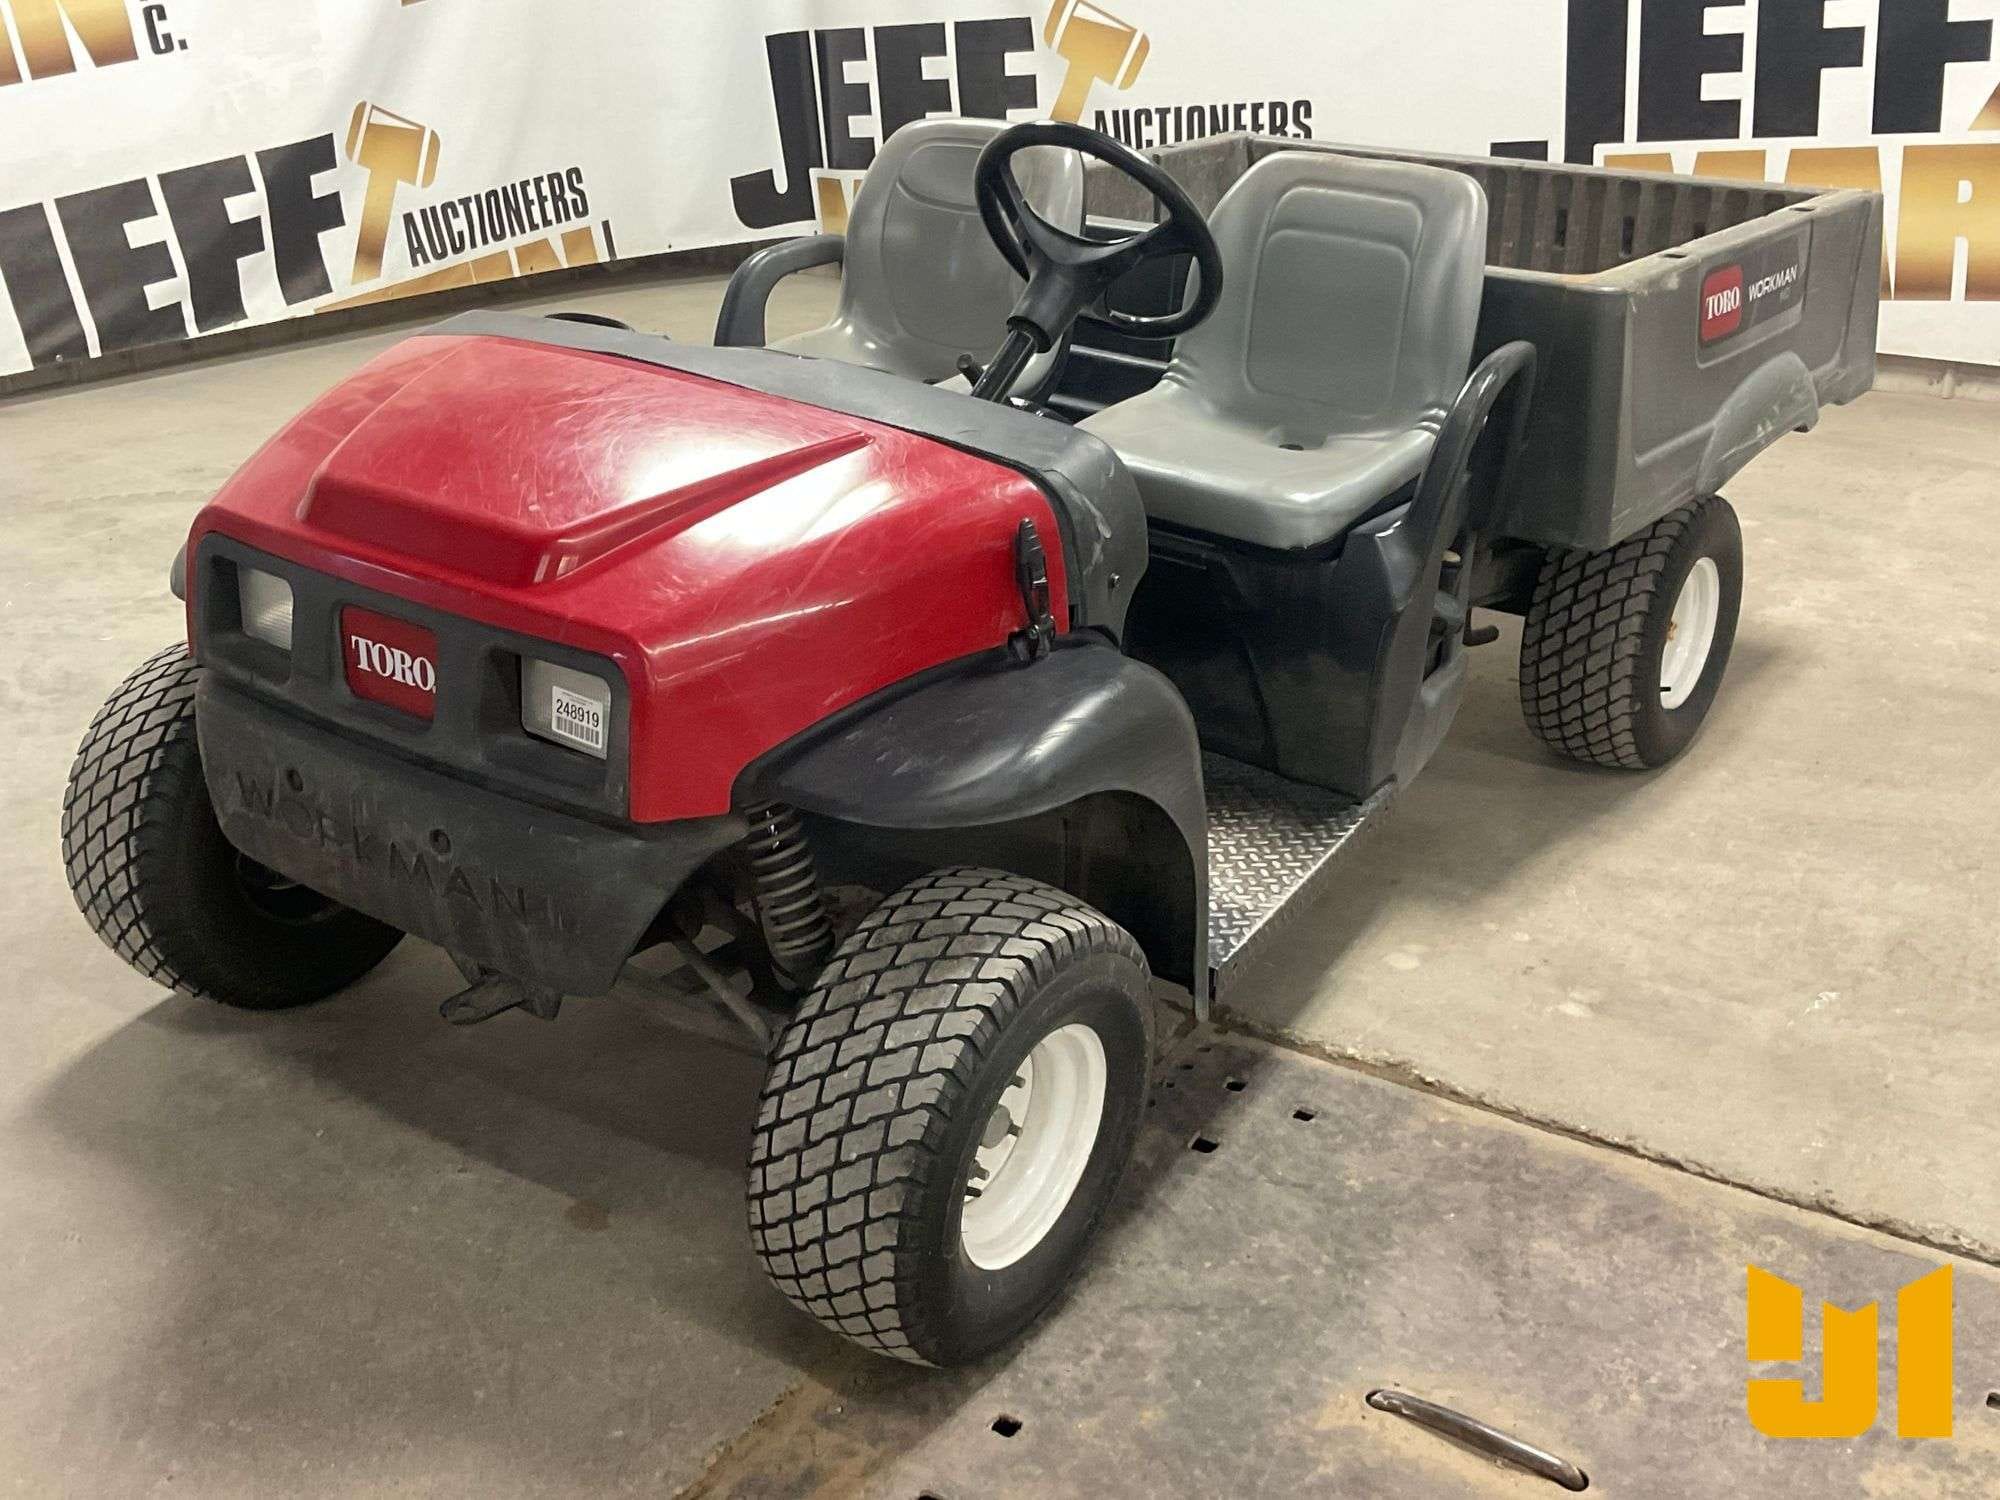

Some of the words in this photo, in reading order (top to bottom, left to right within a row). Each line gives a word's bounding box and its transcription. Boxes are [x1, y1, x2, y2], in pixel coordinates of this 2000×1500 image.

[729, 17, 1037, 228] JEFF
[1095, 100, 1312, 149] AUCTIONEERS
[402, 166, 590, 267] AUCTIONEERS
[1706, 286, 1740, 320] TORO
[1748, 264, 1798, 302] WORKMAN
[351, 635, 436, 693] TORO
[556, 698, 599, 728] 248919
